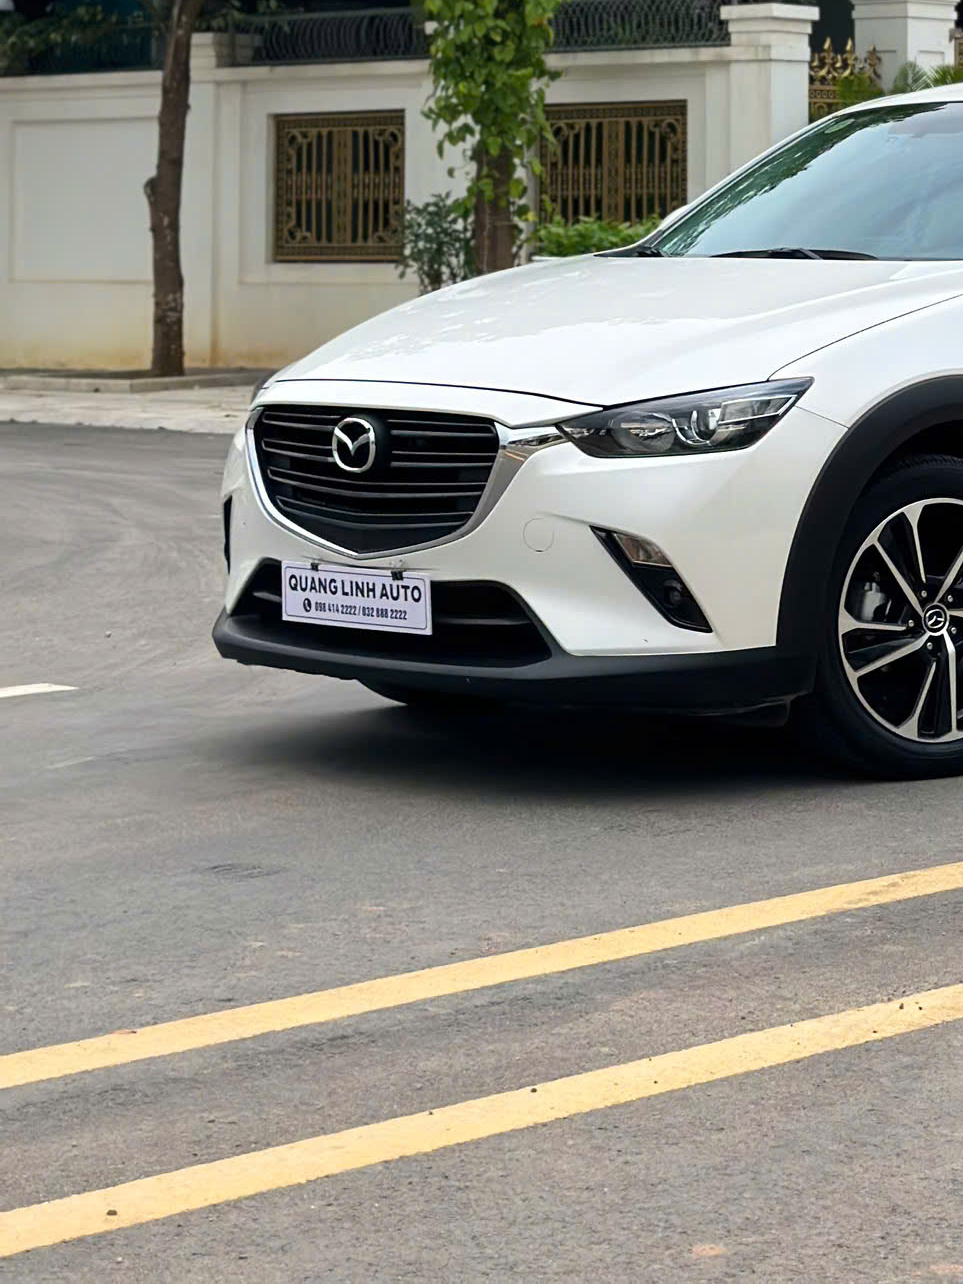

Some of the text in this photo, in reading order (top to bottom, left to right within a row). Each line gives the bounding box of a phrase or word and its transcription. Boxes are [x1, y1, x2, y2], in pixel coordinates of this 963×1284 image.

[288, 574, 422, 603] QUANG LINH AUTO
[341, 604, 357, 616] 2222
[390, 608, 407, 620] 2222
